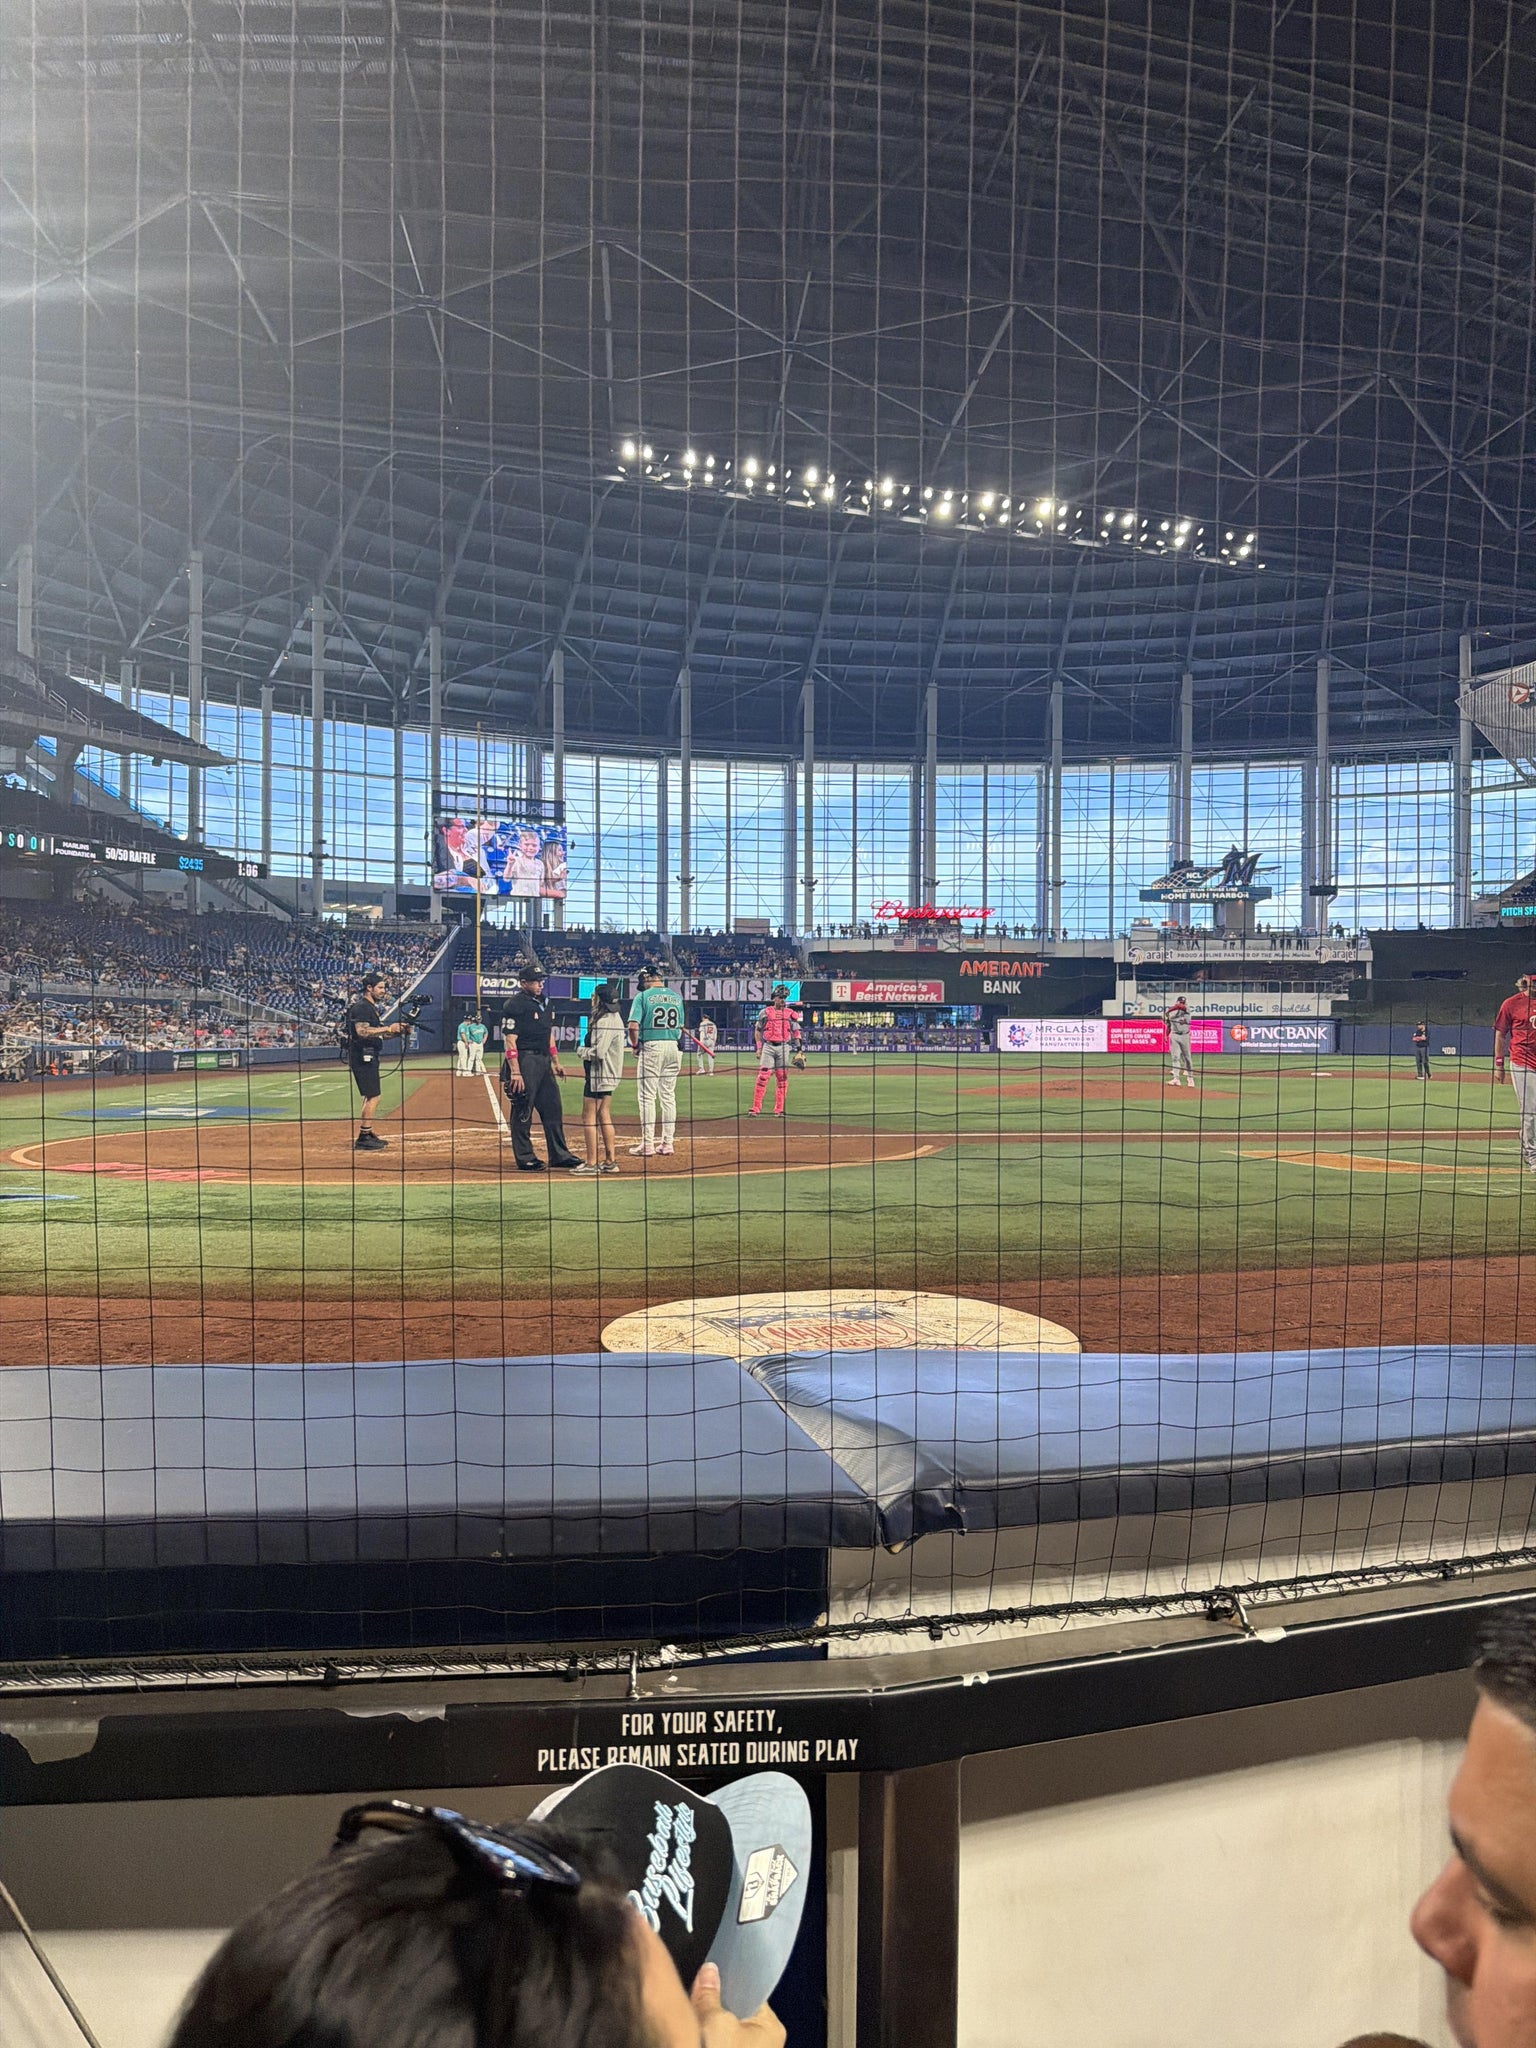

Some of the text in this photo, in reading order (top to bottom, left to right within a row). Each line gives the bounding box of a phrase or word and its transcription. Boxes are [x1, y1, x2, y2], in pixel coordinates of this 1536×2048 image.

[54, 848, 97, 859] FOUNDATION
[62, 841, 90, 851] MARLINS
[105, 847, 157, 865] 50/50 RAFFLE
[238, 863, 258, 878] 1:06
[871, 900, 996, 920] Budweiser
[1501, 906, 1523, 917] PITCH
[1146, 947, 1174, 962] arajet
[1332, 947, 1357, 962] arajet
[959, 960, 1043, 977] AMERANT
[865, 982, 928, 993] America's
[983, 981, 1022, 994] BANK
[855, 991, 938, 1001] Best Network
[652, 1006, 679, 1029] 28
[1442, 1047, 1456, 1055] 400
[767, 1321, 900, 1340] NATIONAL
[621, 1709, 783, 1736] FOR YOUR SAFETY,
[537, 1738, 858, 1772] PLEASE REMAIN SEATED DURING PLAY
